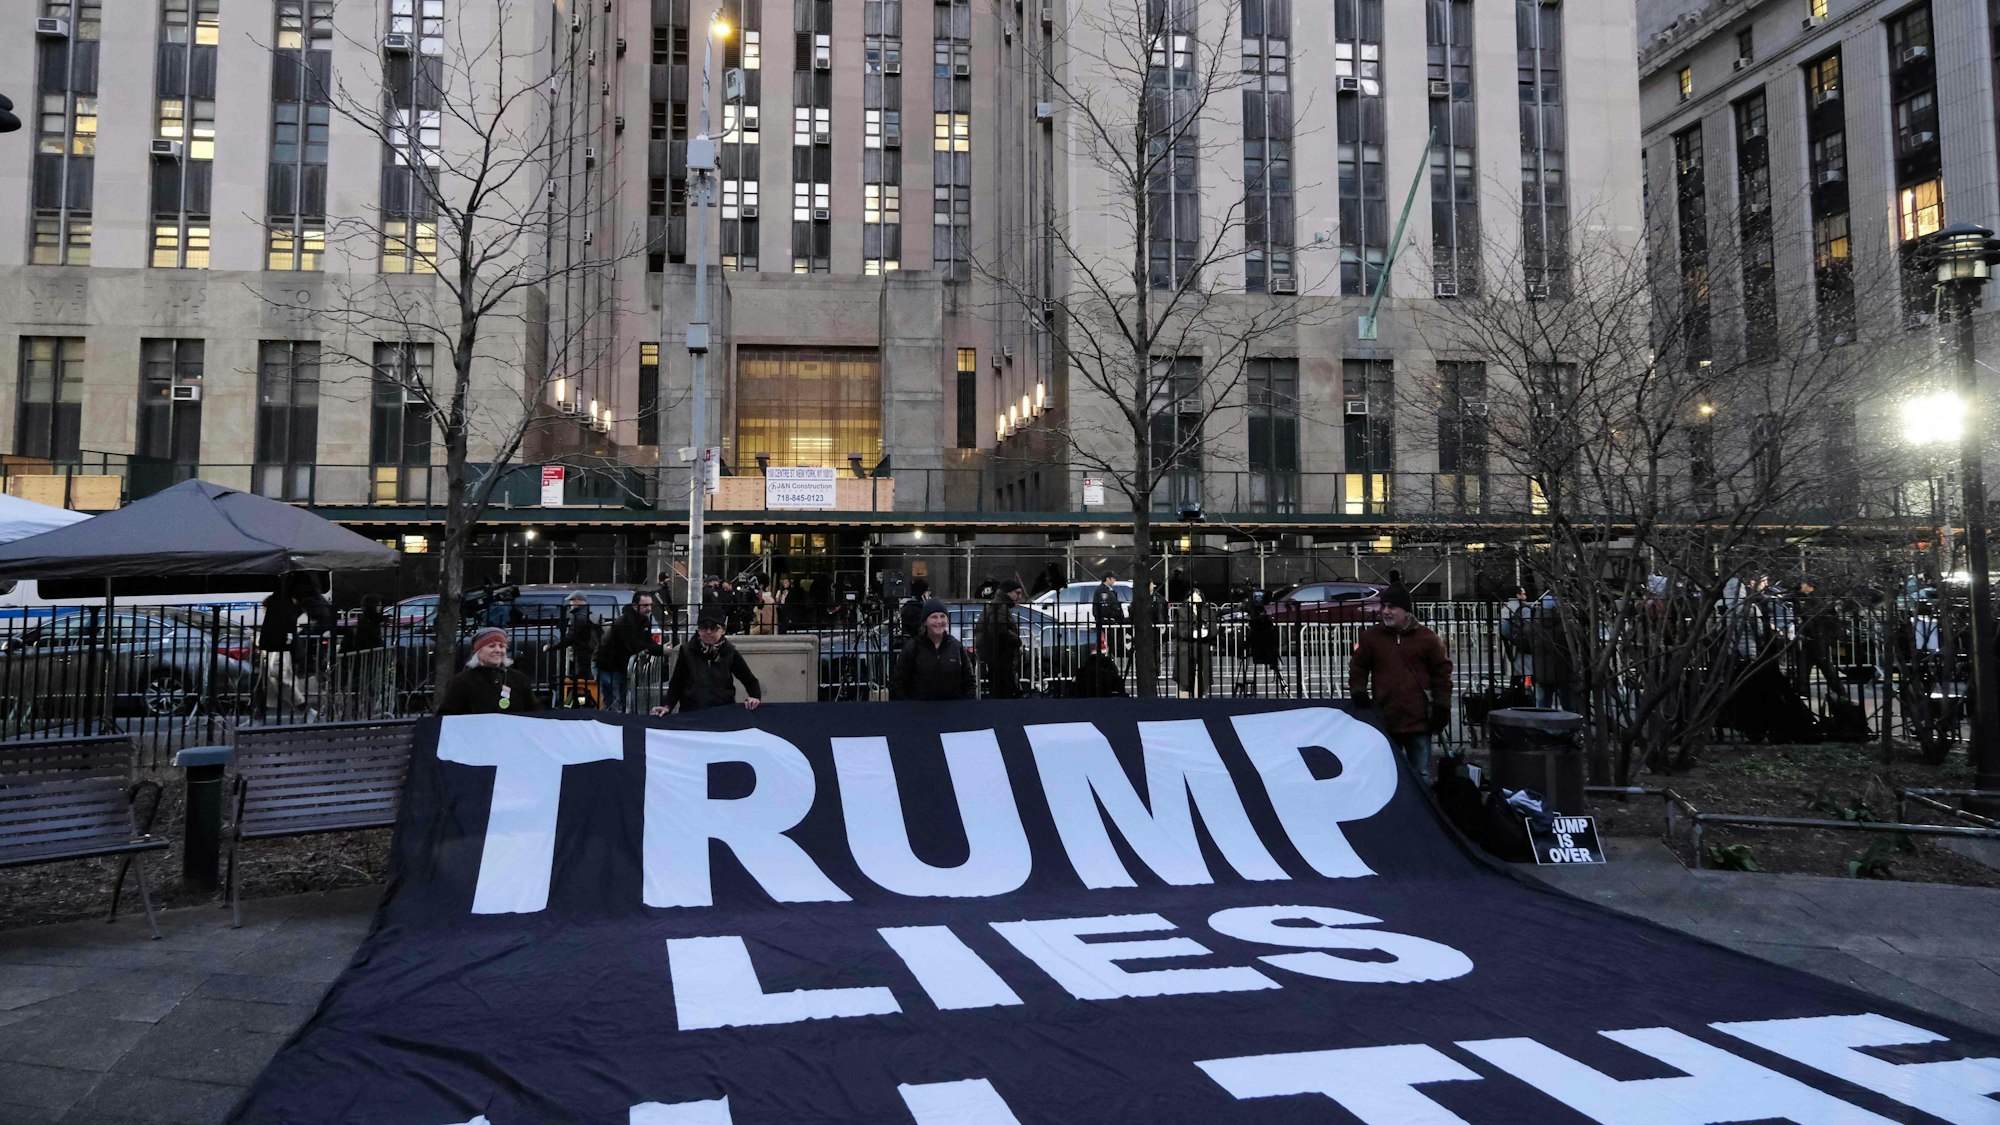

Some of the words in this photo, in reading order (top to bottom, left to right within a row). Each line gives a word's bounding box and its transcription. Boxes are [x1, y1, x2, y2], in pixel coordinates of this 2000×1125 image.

[775, 469, 789, 478] CENTRE
[796, 469, 804, 478] NEW
[436, 706, 1398, 915] TRUMP
[1557, 834, 1574, 848] IS
[1549, 848, 1593, 863] OVER
[666, 905, 1474, 1032] LIES
[1194, 1012, 2000, 1125] THE
